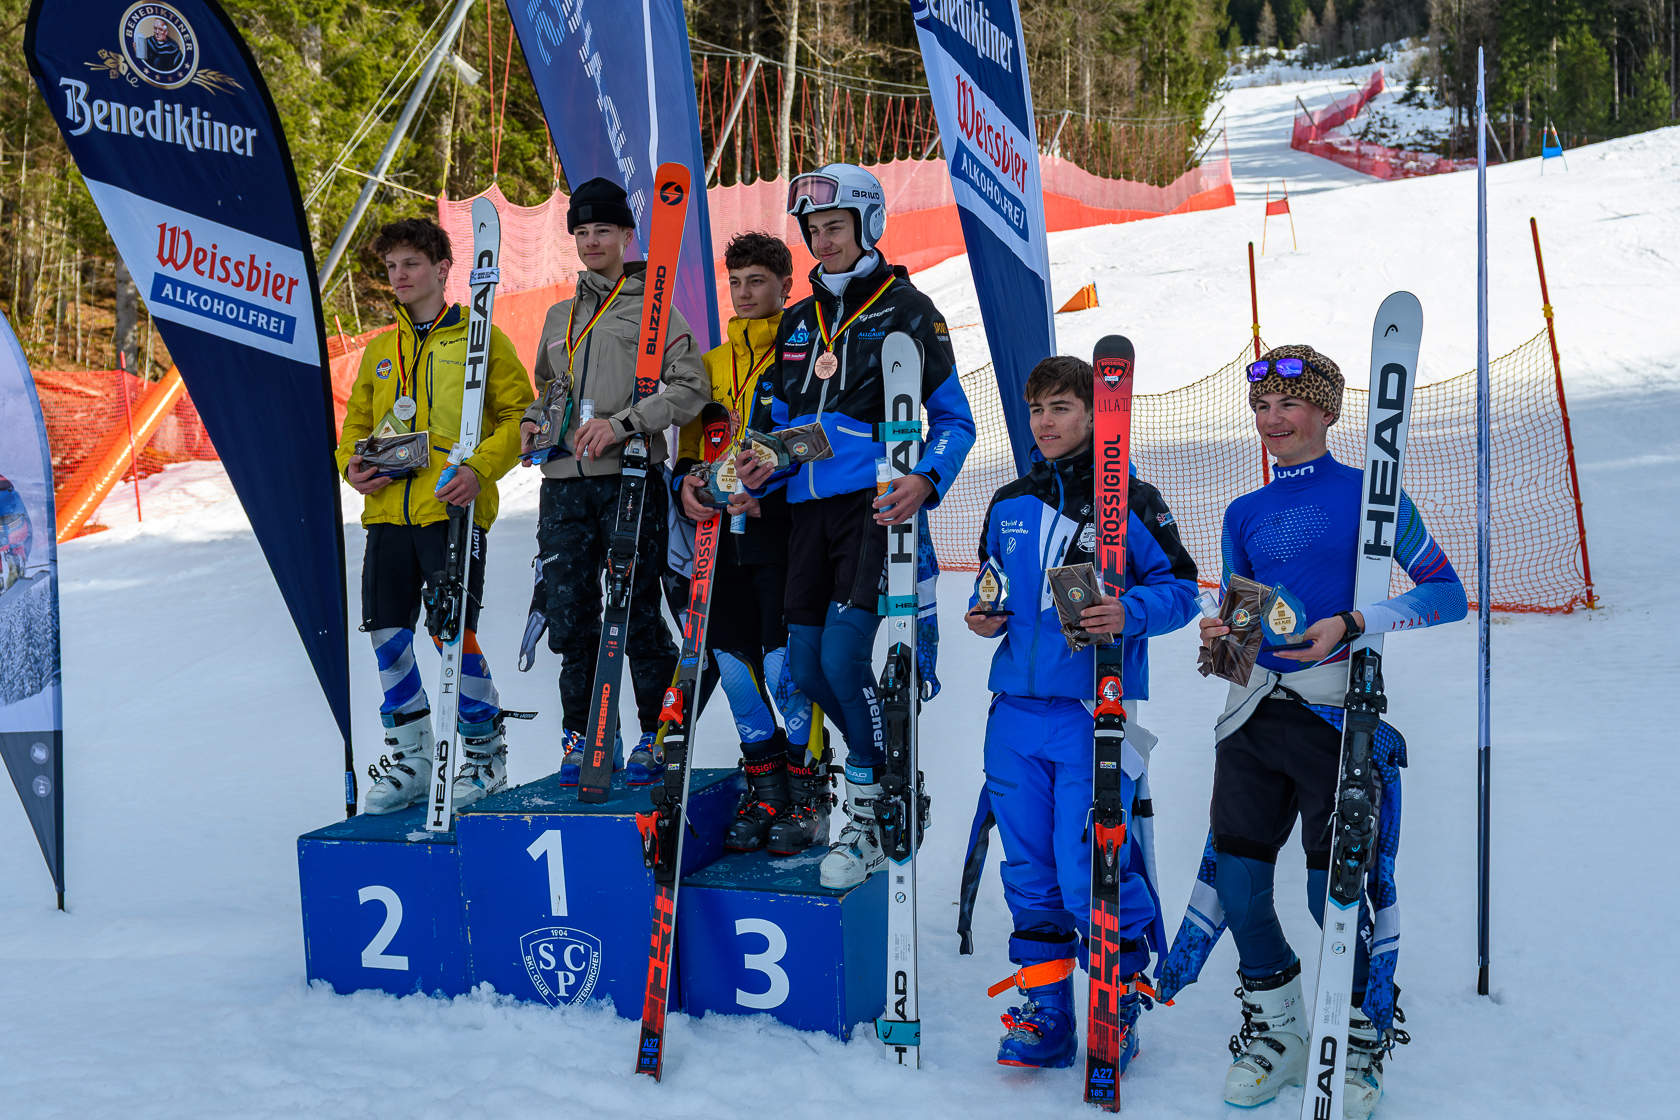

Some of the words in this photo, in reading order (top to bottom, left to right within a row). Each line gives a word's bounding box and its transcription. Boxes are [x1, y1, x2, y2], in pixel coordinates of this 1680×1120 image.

[126, 6, 194, 52] BENEDIKTINER
[912, 0, 1013, 73] enediktiner
[59, 77, 259, 157] Benediktiner
[956, 73, 1028, 195] Weissbier
[960, 152, 1025, 230] ALKOHOLFREI
[156, 222, 299, 305] Weissbier
[160, 282, 286, 336] ALKOHOLFREI
[645, 265, 667, 356] BLIZZARD
[787, 332, 810, 343] ASV
[1102, 433, 1122, 547] ROSSIGNOL
[1363, 362, 1408, 558] HEAD
[471, 528, 480, 560] Audi
[1391, 609, 1441, 630] ITALIA
[595, 683, 611, 747] FIREBIRD
[862, 686, 884, 751] ziener
[433, 739, 449, 827] HEAD
[526, 829, 569, 917] 1
[357, 885, 410, 971] 2
[551, 929, 568, 937] 1904
[735, 917, 790, 1010] 3
[575, 951, 600, 1005] RTENKIRCHEN
[643, 1038, 659, 1048] A27
[1092, 1067, 1113, 1079] A27
[1314, 1035, 1338, 1120] EAD
[1090, 1088, 1104, 1097] 185
